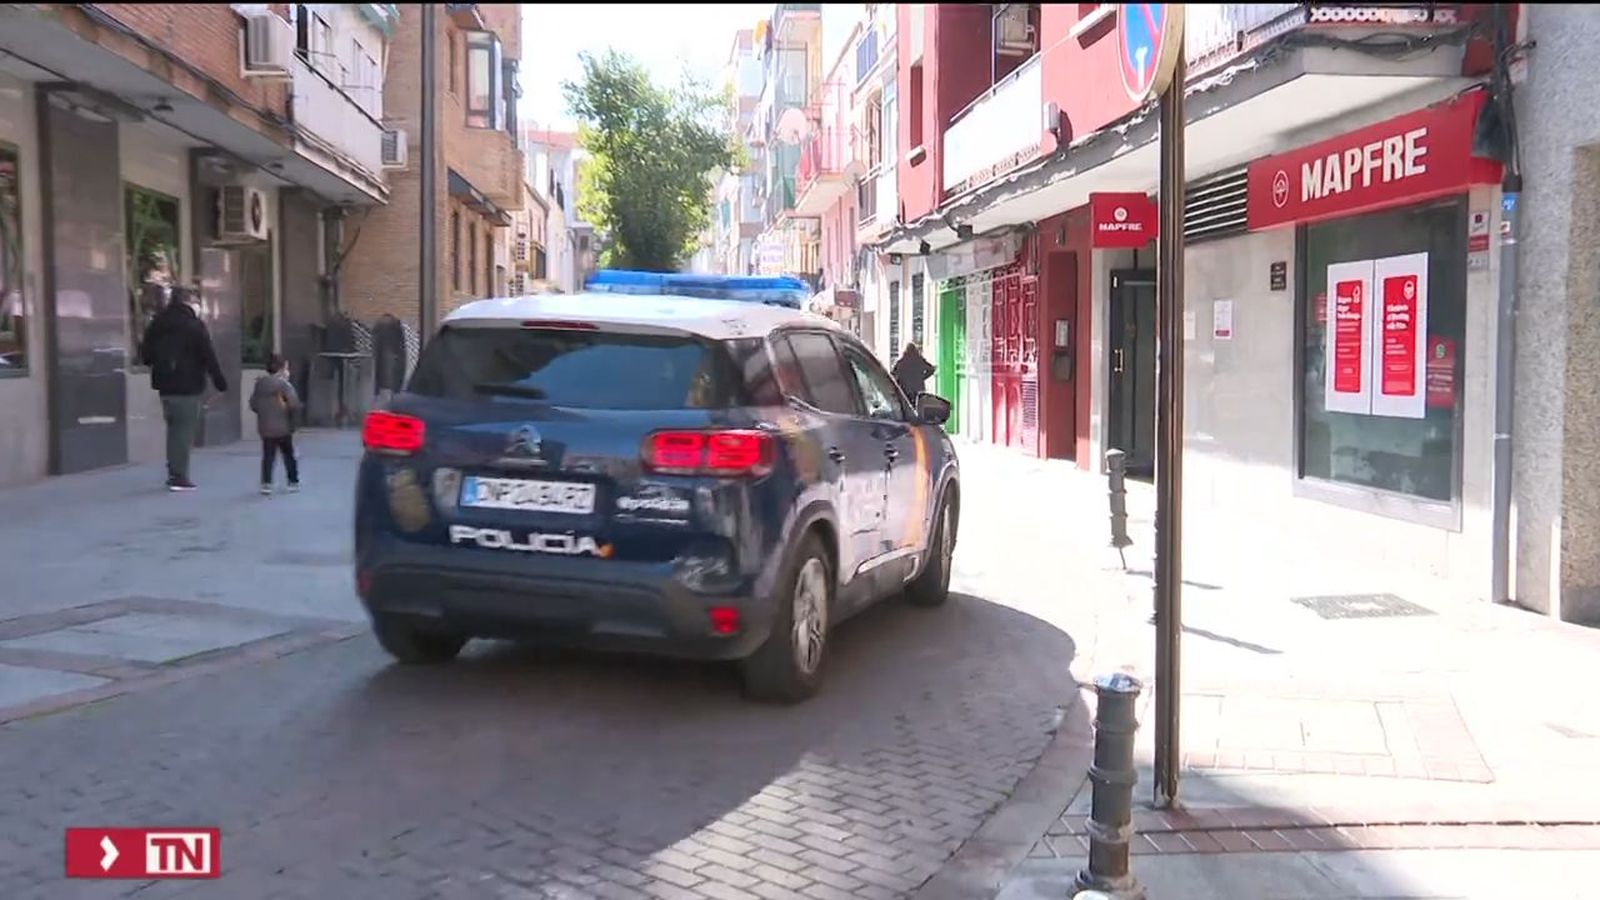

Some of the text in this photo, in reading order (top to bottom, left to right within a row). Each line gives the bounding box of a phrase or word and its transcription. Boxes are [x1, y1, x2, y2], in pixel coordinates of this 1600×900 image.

[1301, 127, 1428, 202] MAPFRE
[1098, 222, 1143, 231] MAPFRE
[449, 524, 601, 556] POLICÍA
